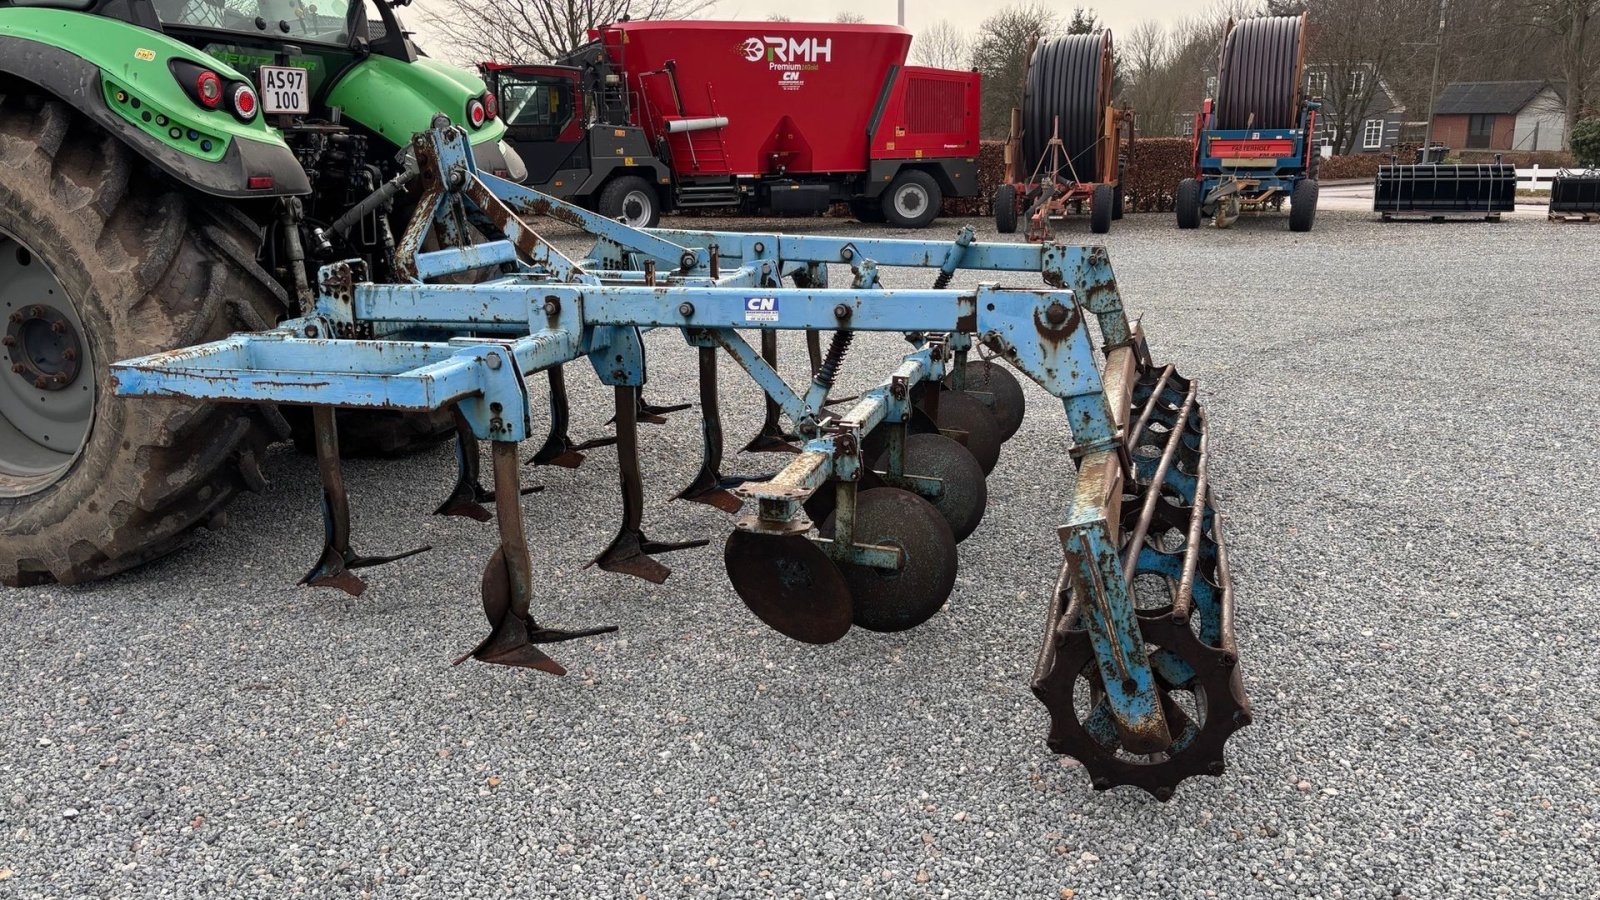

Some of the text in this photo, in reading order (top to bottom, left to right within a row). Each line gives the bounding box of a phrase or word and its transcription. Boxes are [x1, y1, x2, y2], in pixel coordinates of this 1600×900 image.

[764, 35, 831, 62] RMH
[769, 62, 801, 71] Premium
[267, 70, 303, 89] AS97
[783, 71, 799, 80] CN
[275, 91, 299, 109] 100
[747, 298, 775, 310] CN
